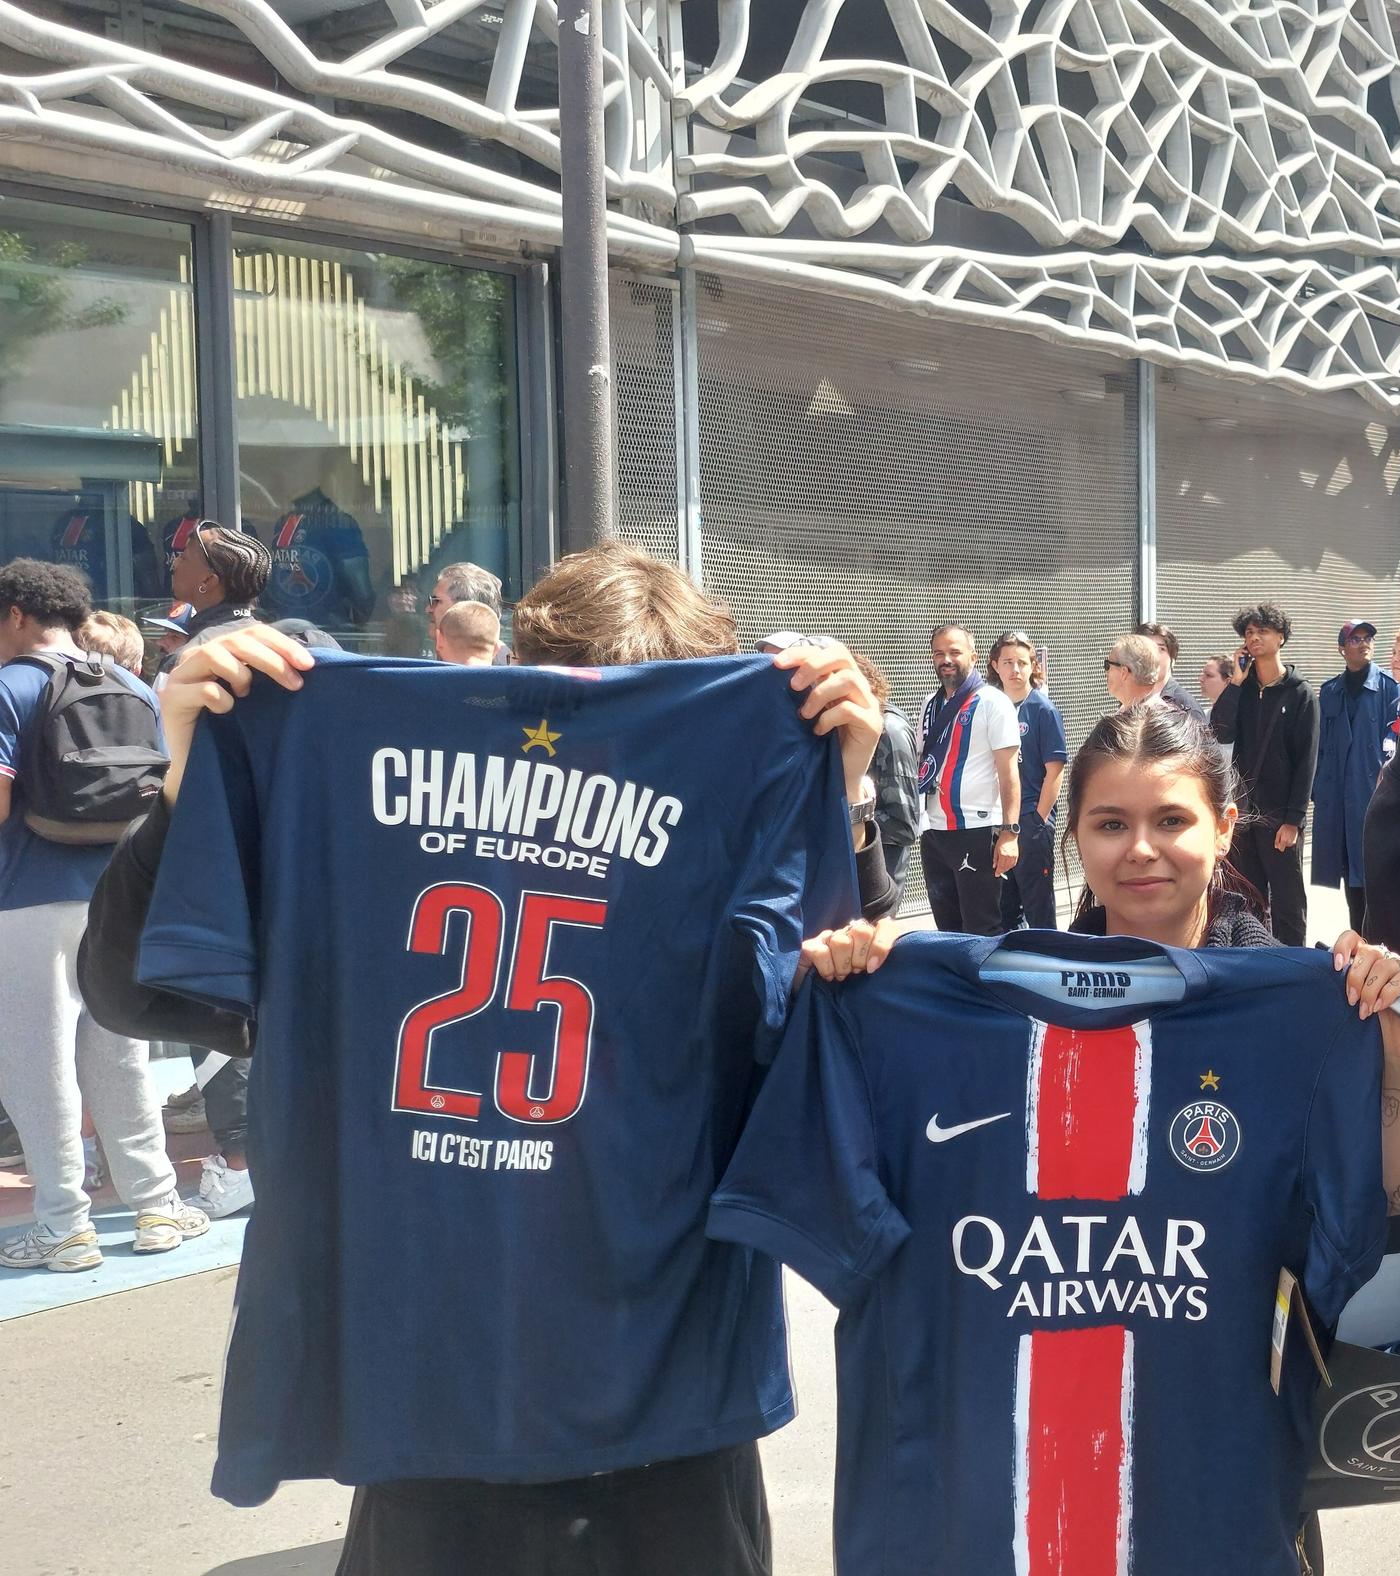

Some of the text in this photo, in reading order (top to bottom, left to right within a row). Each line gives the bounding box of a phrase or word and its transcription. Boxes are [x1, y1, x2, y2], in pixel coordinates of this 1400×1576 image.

[371, 747, 684, 868] CHAMPIONS
[420, 832, 611, 879] OF EUROPE
[1059, 970, 1132, 987] PARIS
[391, 881, 608, 1125] 25
[1183, 1104, 1230, 1123] PARIS
[411, 1130, 553, 1171] ICI C'EST PARIS
[952, 1215, 1209, 1291] QATAR
[1006, 1278, 1208, 1321] AIRWAYS
